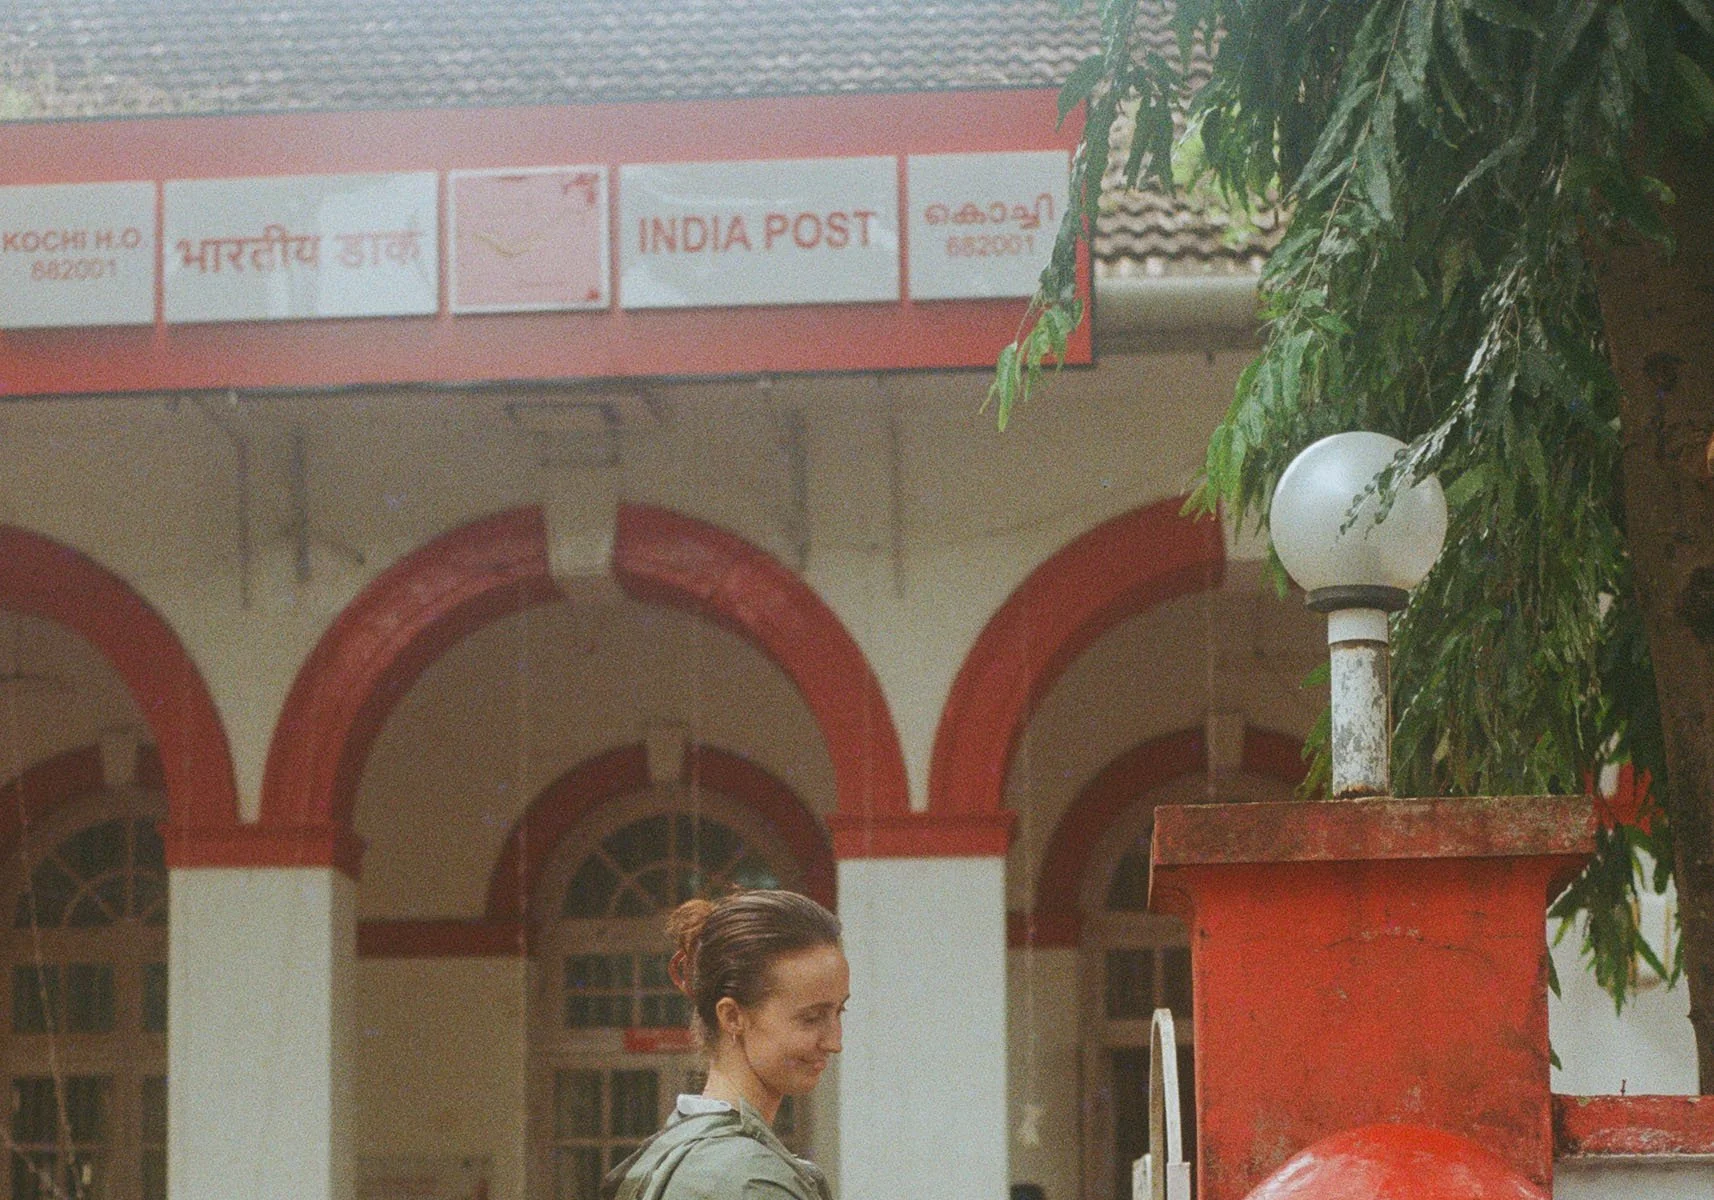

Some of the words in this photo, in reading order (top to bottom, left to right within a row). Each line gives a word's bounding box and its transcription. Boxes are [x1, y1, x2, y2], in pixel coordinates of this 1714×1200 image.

[2, 228, 88, 254] KOCHI
[176, 223, 321, 274] भारतीय
[333, 229, 424, 269] डाक
[638, 215, 751, 255] INDIA
[764, 211, 877, 249] POST
